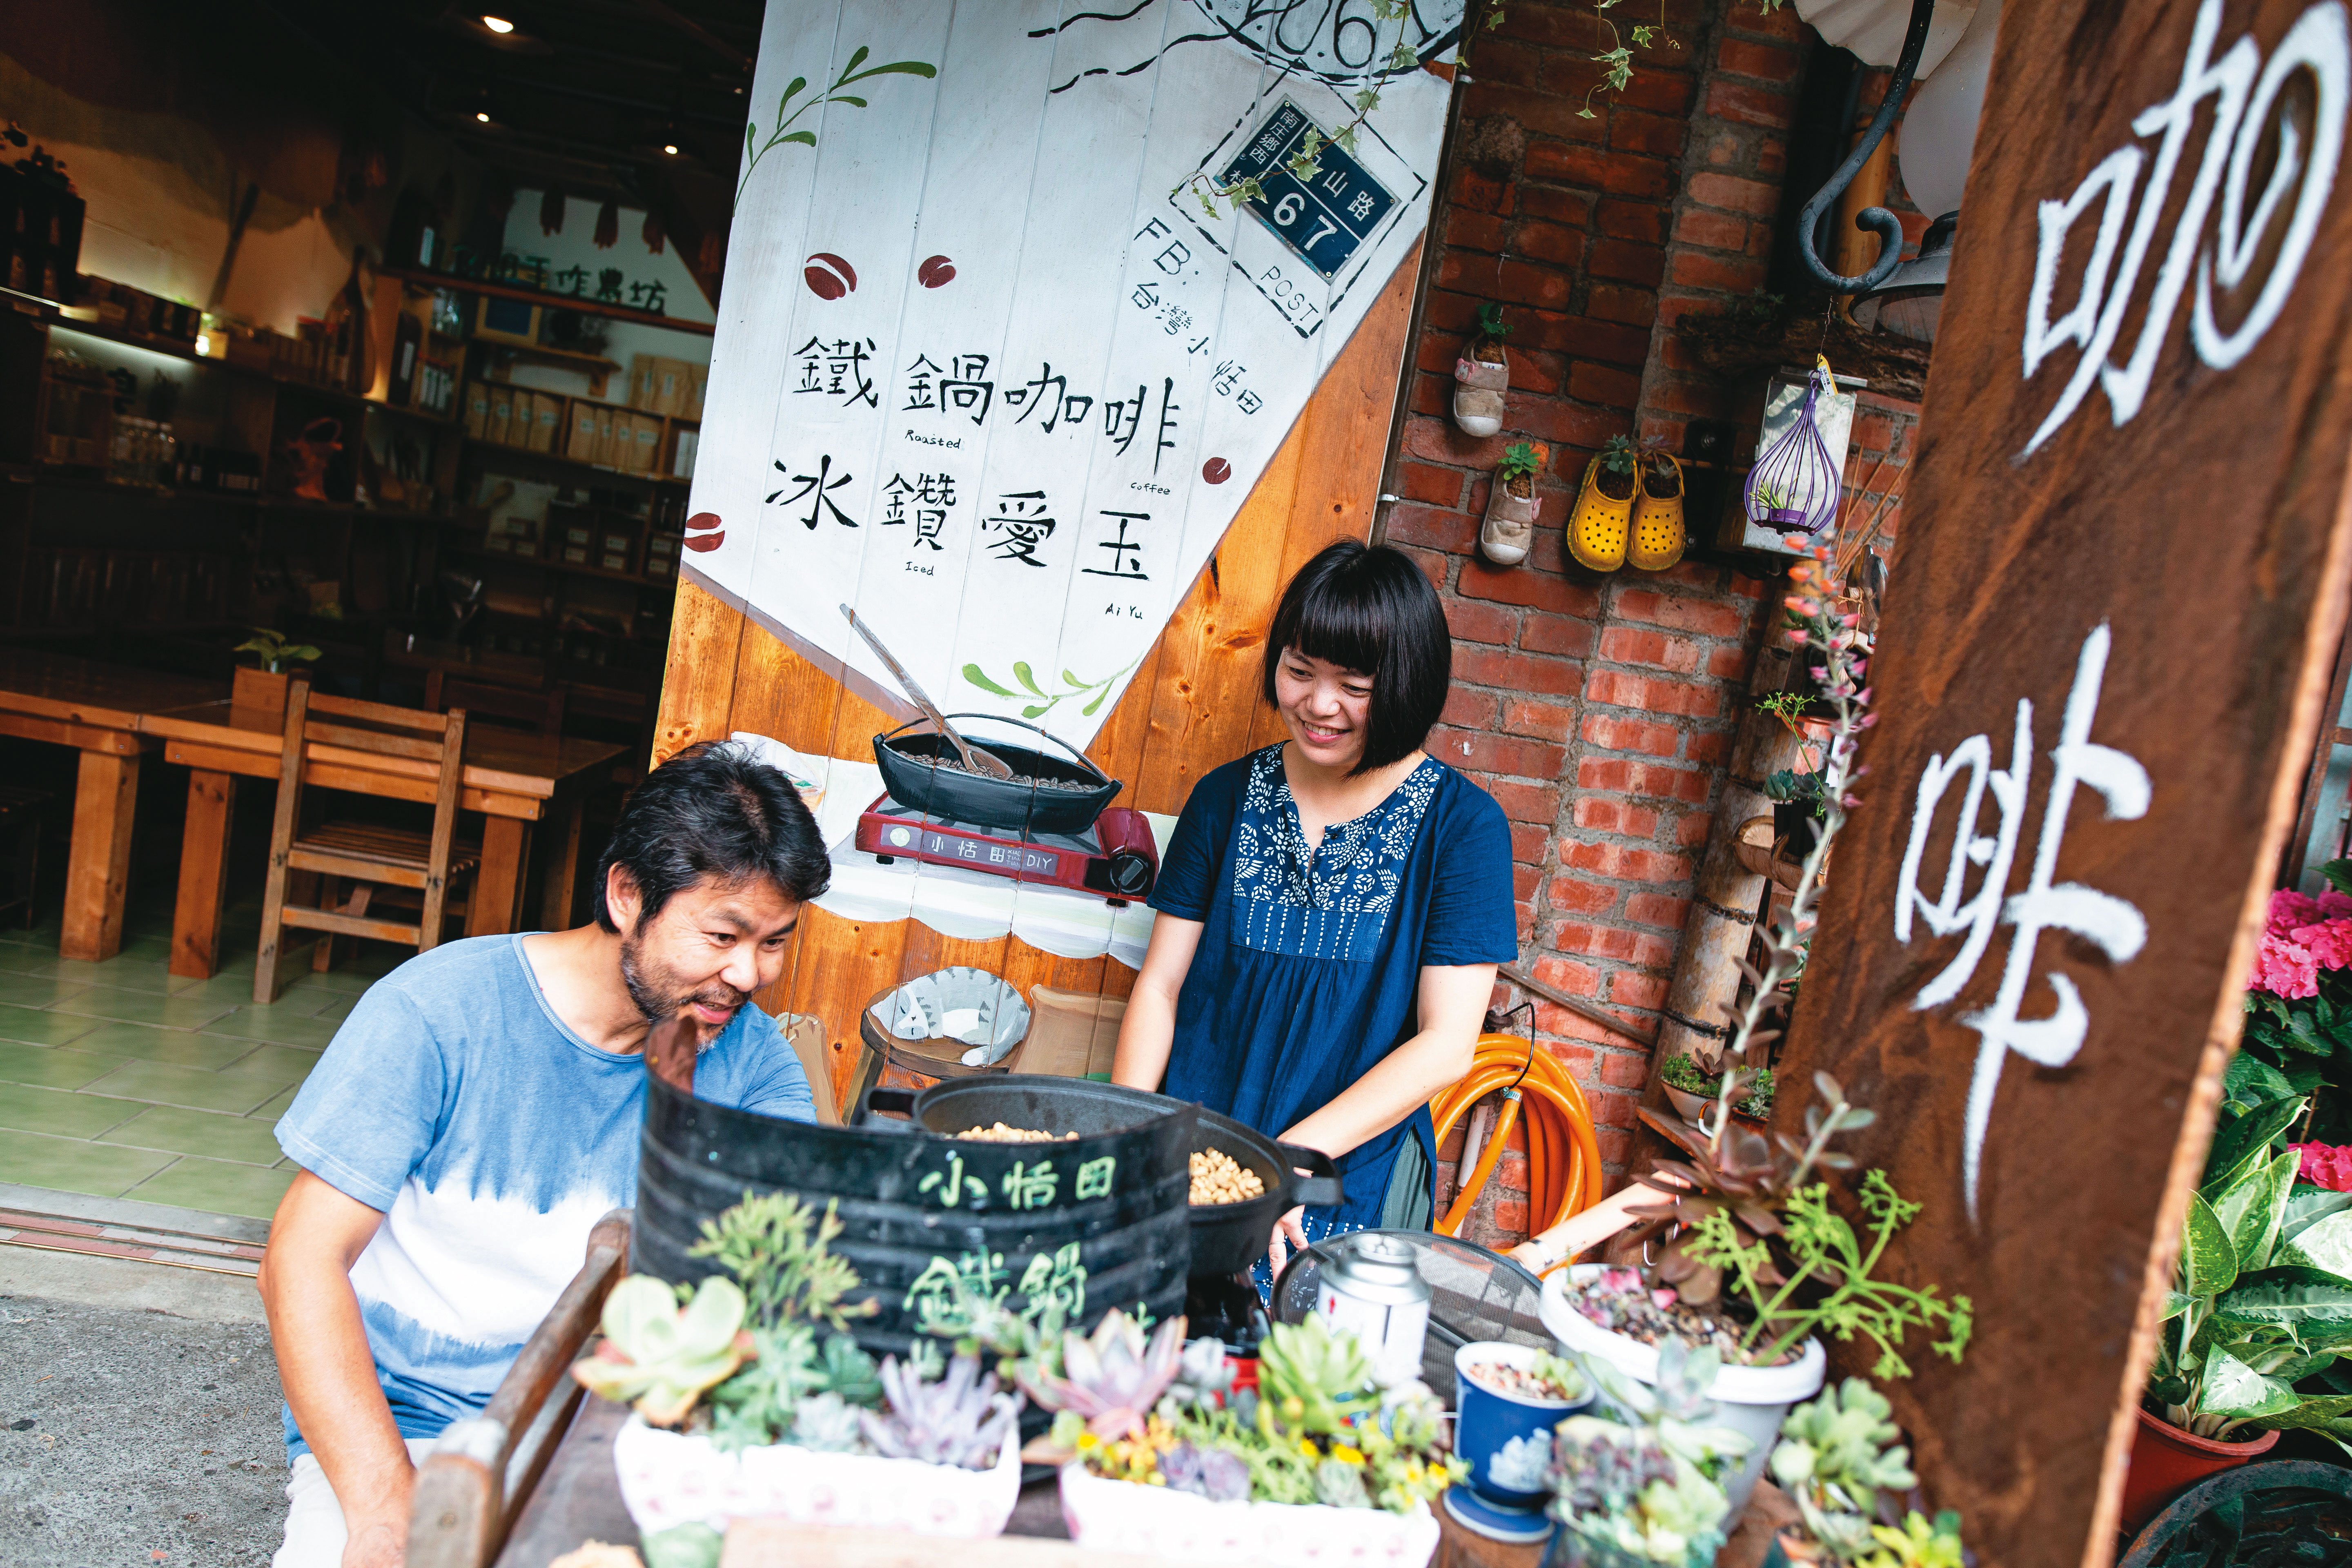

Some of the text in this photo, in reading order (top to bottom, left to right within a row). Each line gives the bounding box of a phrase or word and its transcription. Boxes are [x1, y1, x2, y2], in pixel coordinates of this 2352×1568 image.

[1301, 148, 1375, 222] 山路
[1274, 193, 1338, 251] 67
[1261, 266, 1319, 321] POST
[793, 336, 1181, 476] 鐵鍋咖啡
[904, 430, 961, 449] Roasted
[765, 454, 1150, 581] 冰鑽愛玉
[905, 561, 934, 577] Iced
[1895, 0, 2351, 1222] 咖啡
[931, 836, 1005, 863] 小恬田
[1027, 854, 1052, 869] DIY
[918, 1156, 1116, 1210] 小恬田
